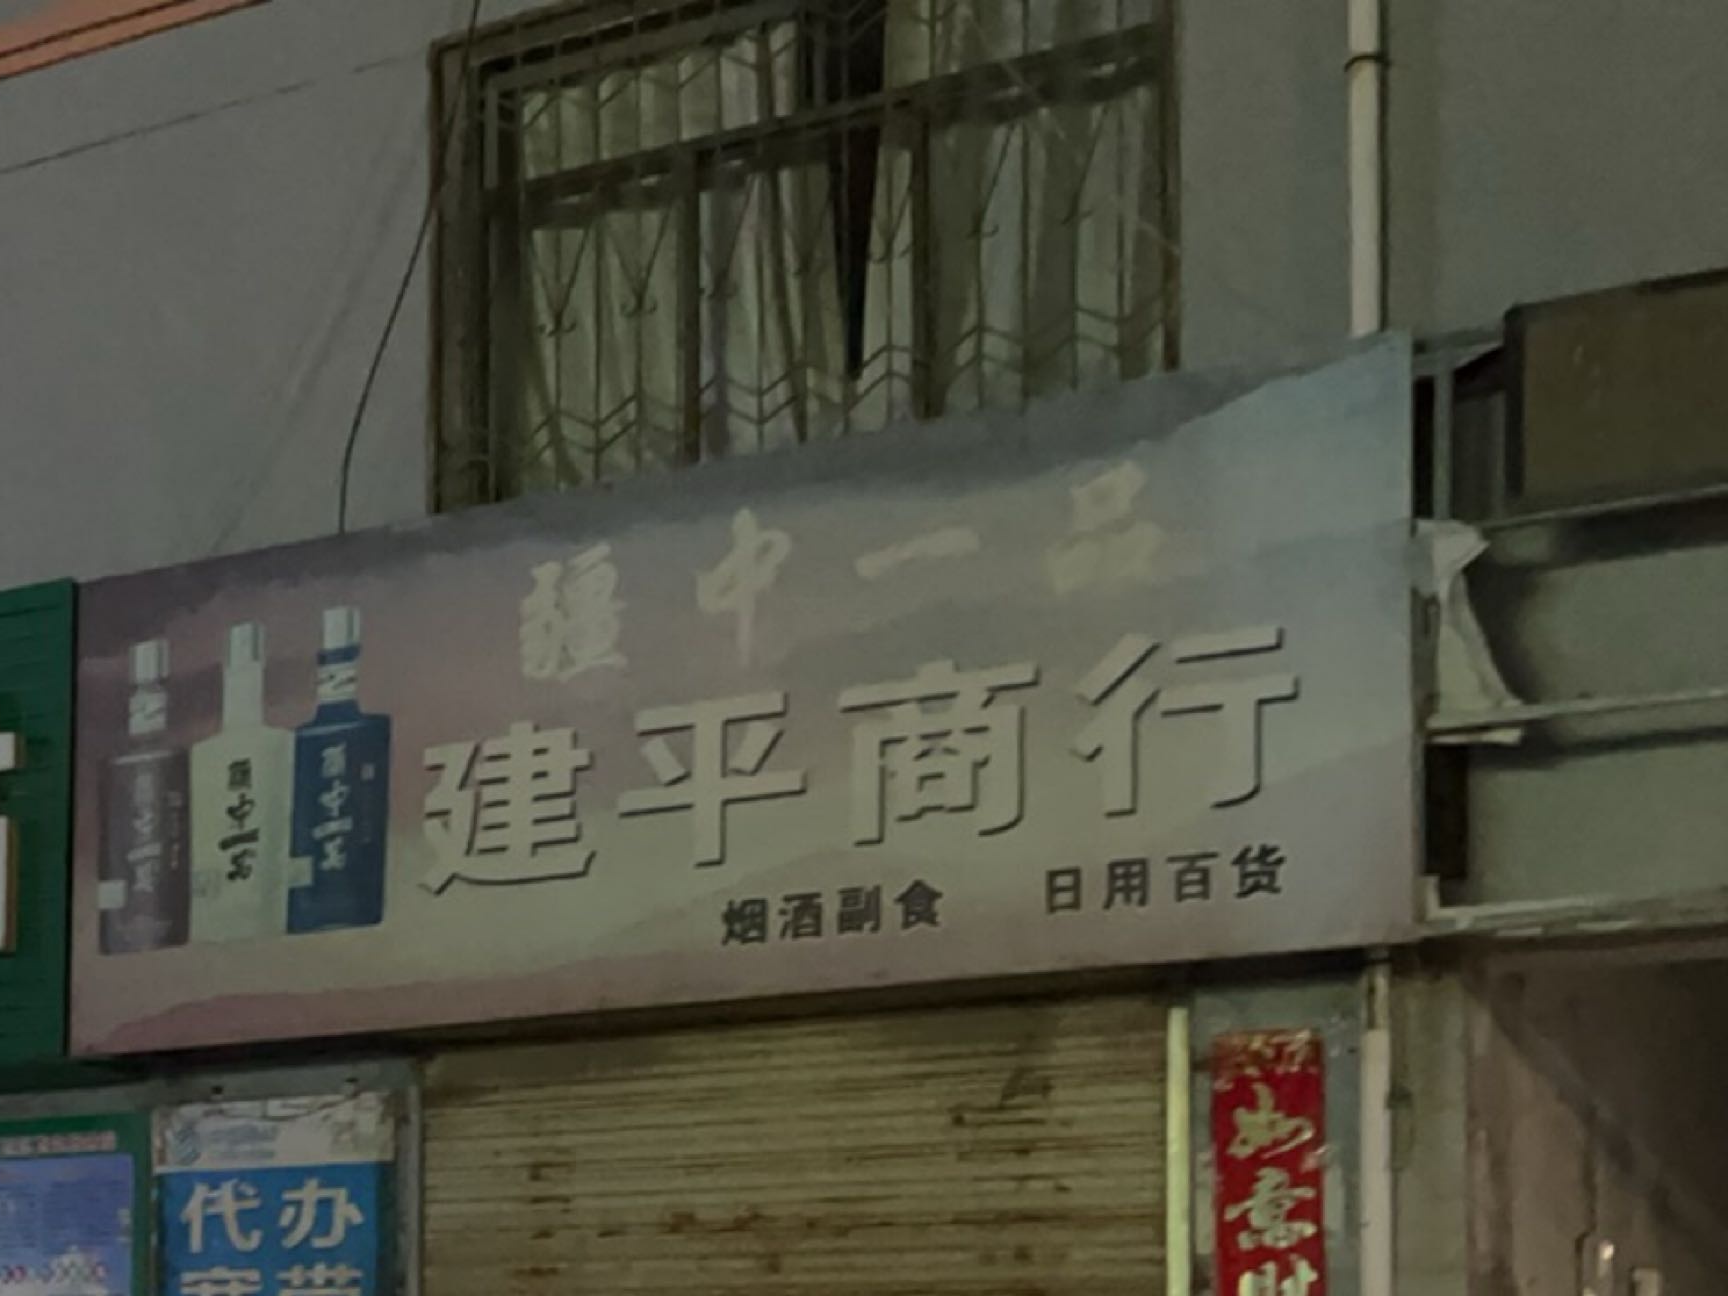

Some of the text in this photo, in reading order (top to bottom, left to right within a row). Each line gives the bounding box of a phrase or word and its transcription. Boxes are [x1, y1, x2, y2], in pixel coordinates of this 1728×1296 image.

[420, 626, 1301, 897] 建平商行
[721, 843, 1287, 946] 烟酒副食 日用百货
[180, 1177, 364, 1254] 代办
